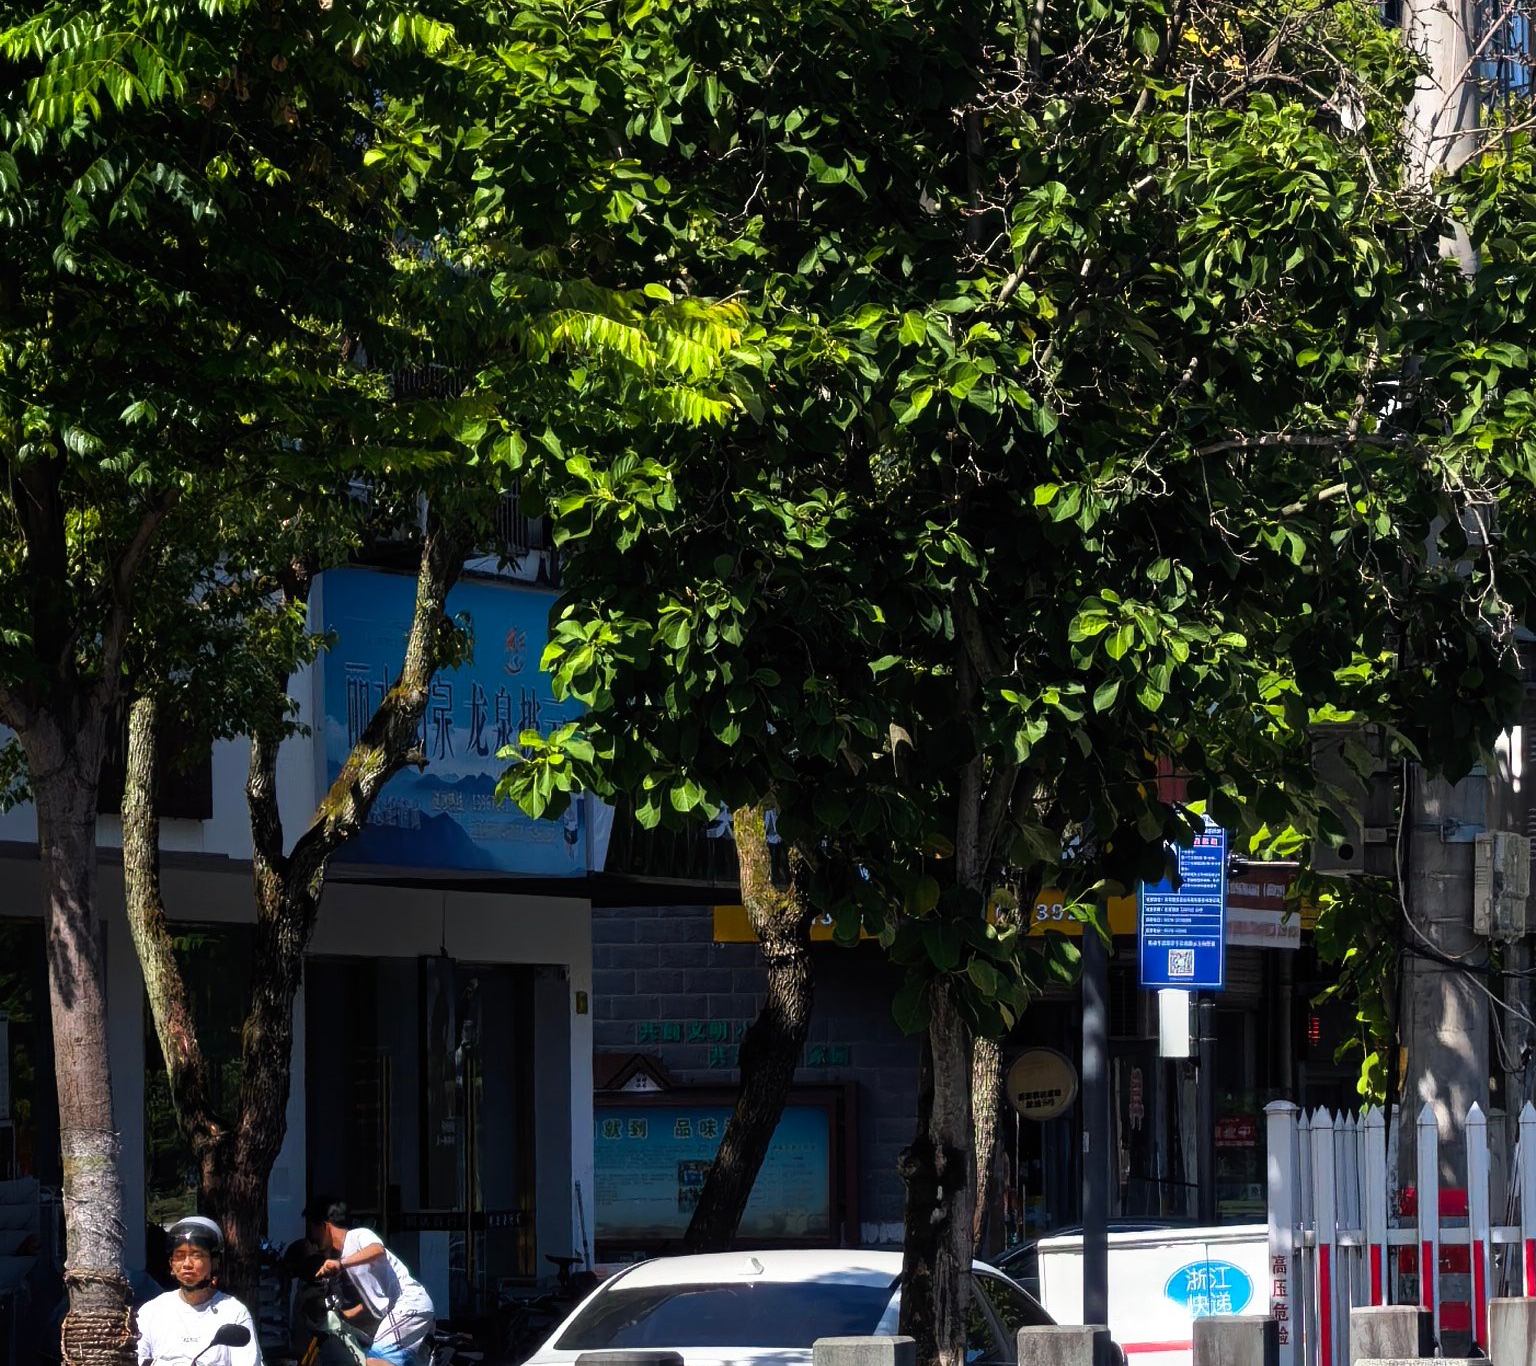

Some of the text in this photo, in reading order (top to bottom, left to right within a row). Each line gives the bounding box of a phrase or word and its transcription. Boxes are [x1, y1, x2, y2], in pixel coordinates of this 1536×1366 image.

[1185, 1266, 1233, 1291] 浙江
[1186, 1291, 1234, 1317] 快递
[1272, 1254, 1290, 1346] 高压危险
